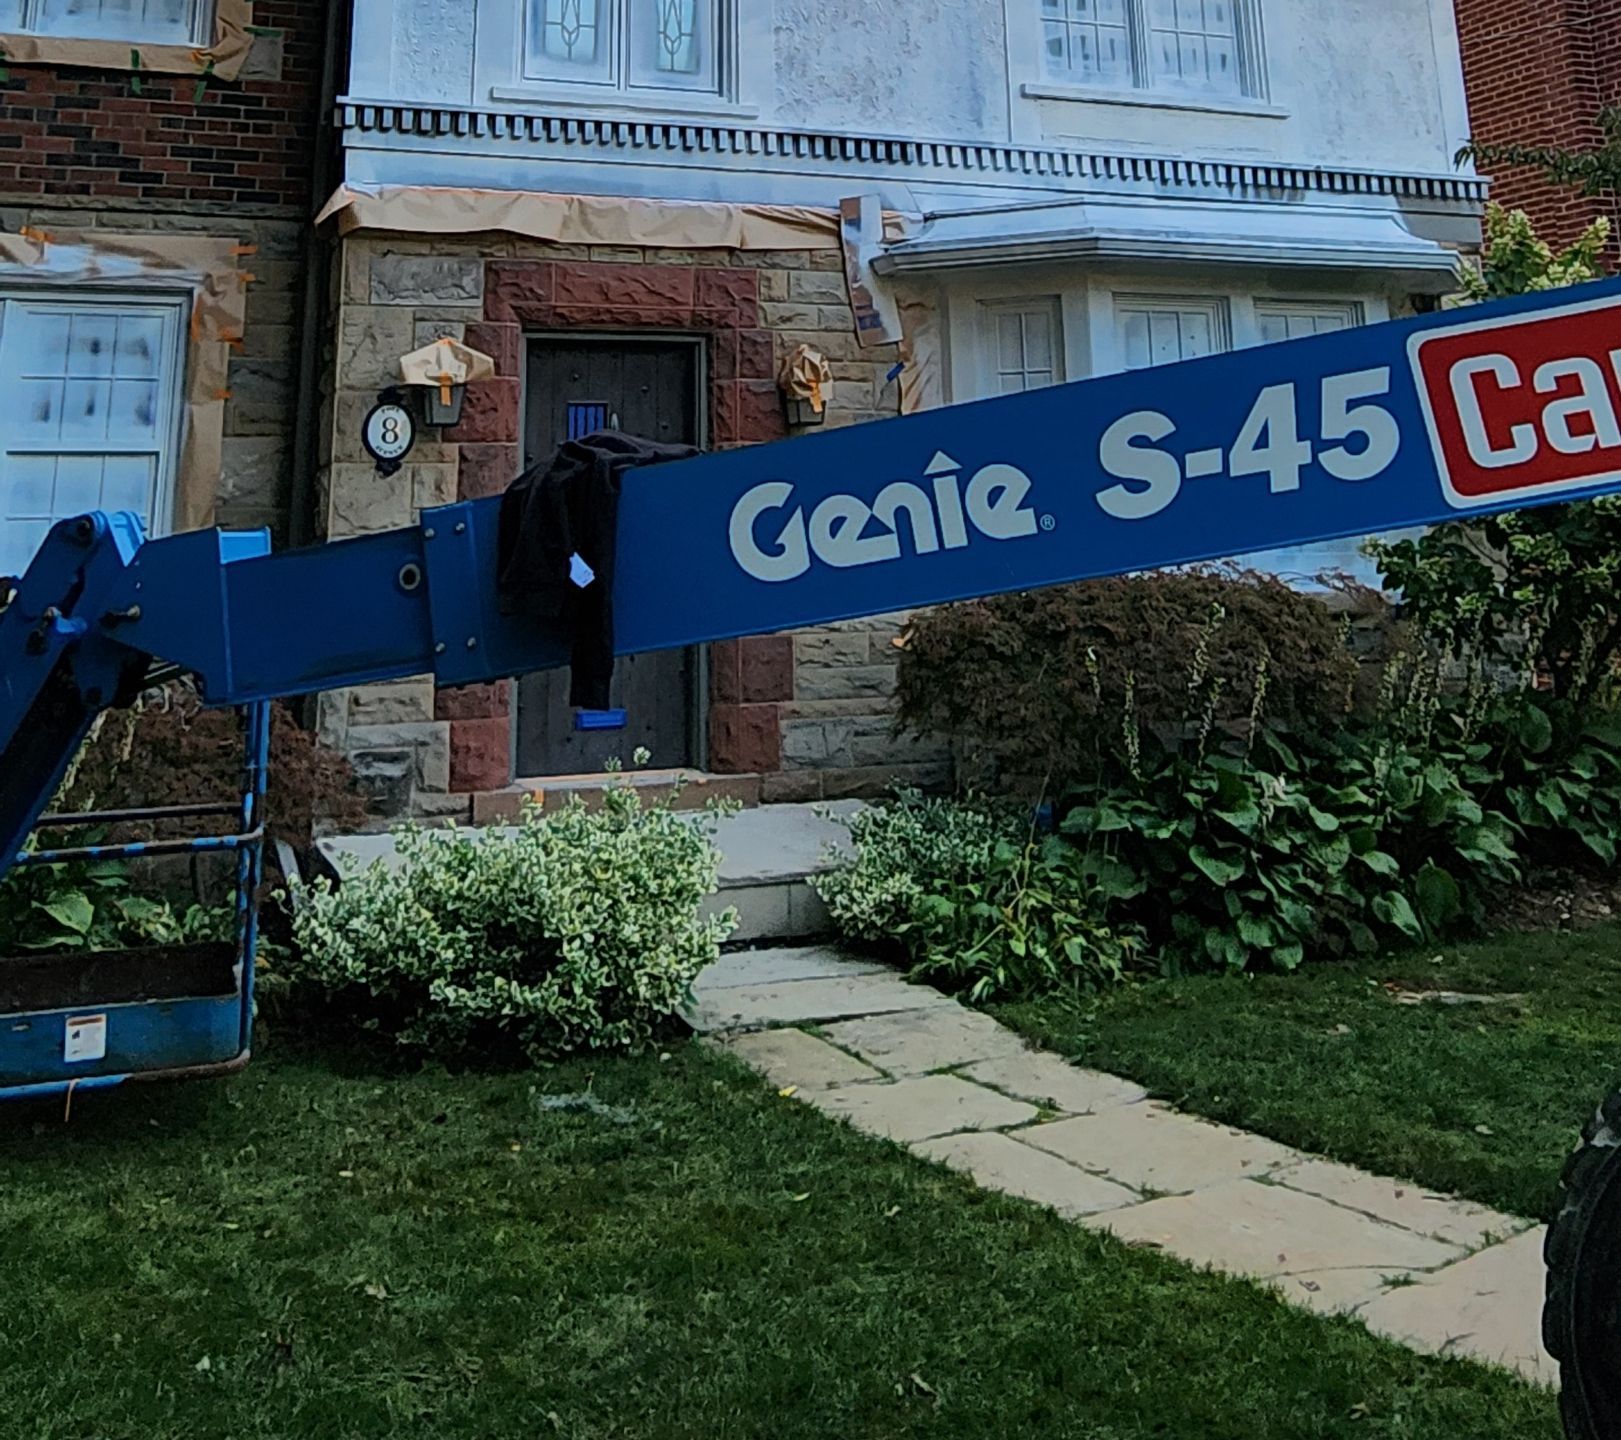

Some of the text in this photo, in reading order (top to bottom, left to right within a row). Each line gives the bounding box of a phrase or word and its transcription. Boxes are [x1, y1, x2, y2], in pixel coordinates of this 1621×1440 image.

[381, 416, 399, 445] 8
[1449, 348, 1621, 469] Ca
[728, 366, 1400, 582] Genie S-45
